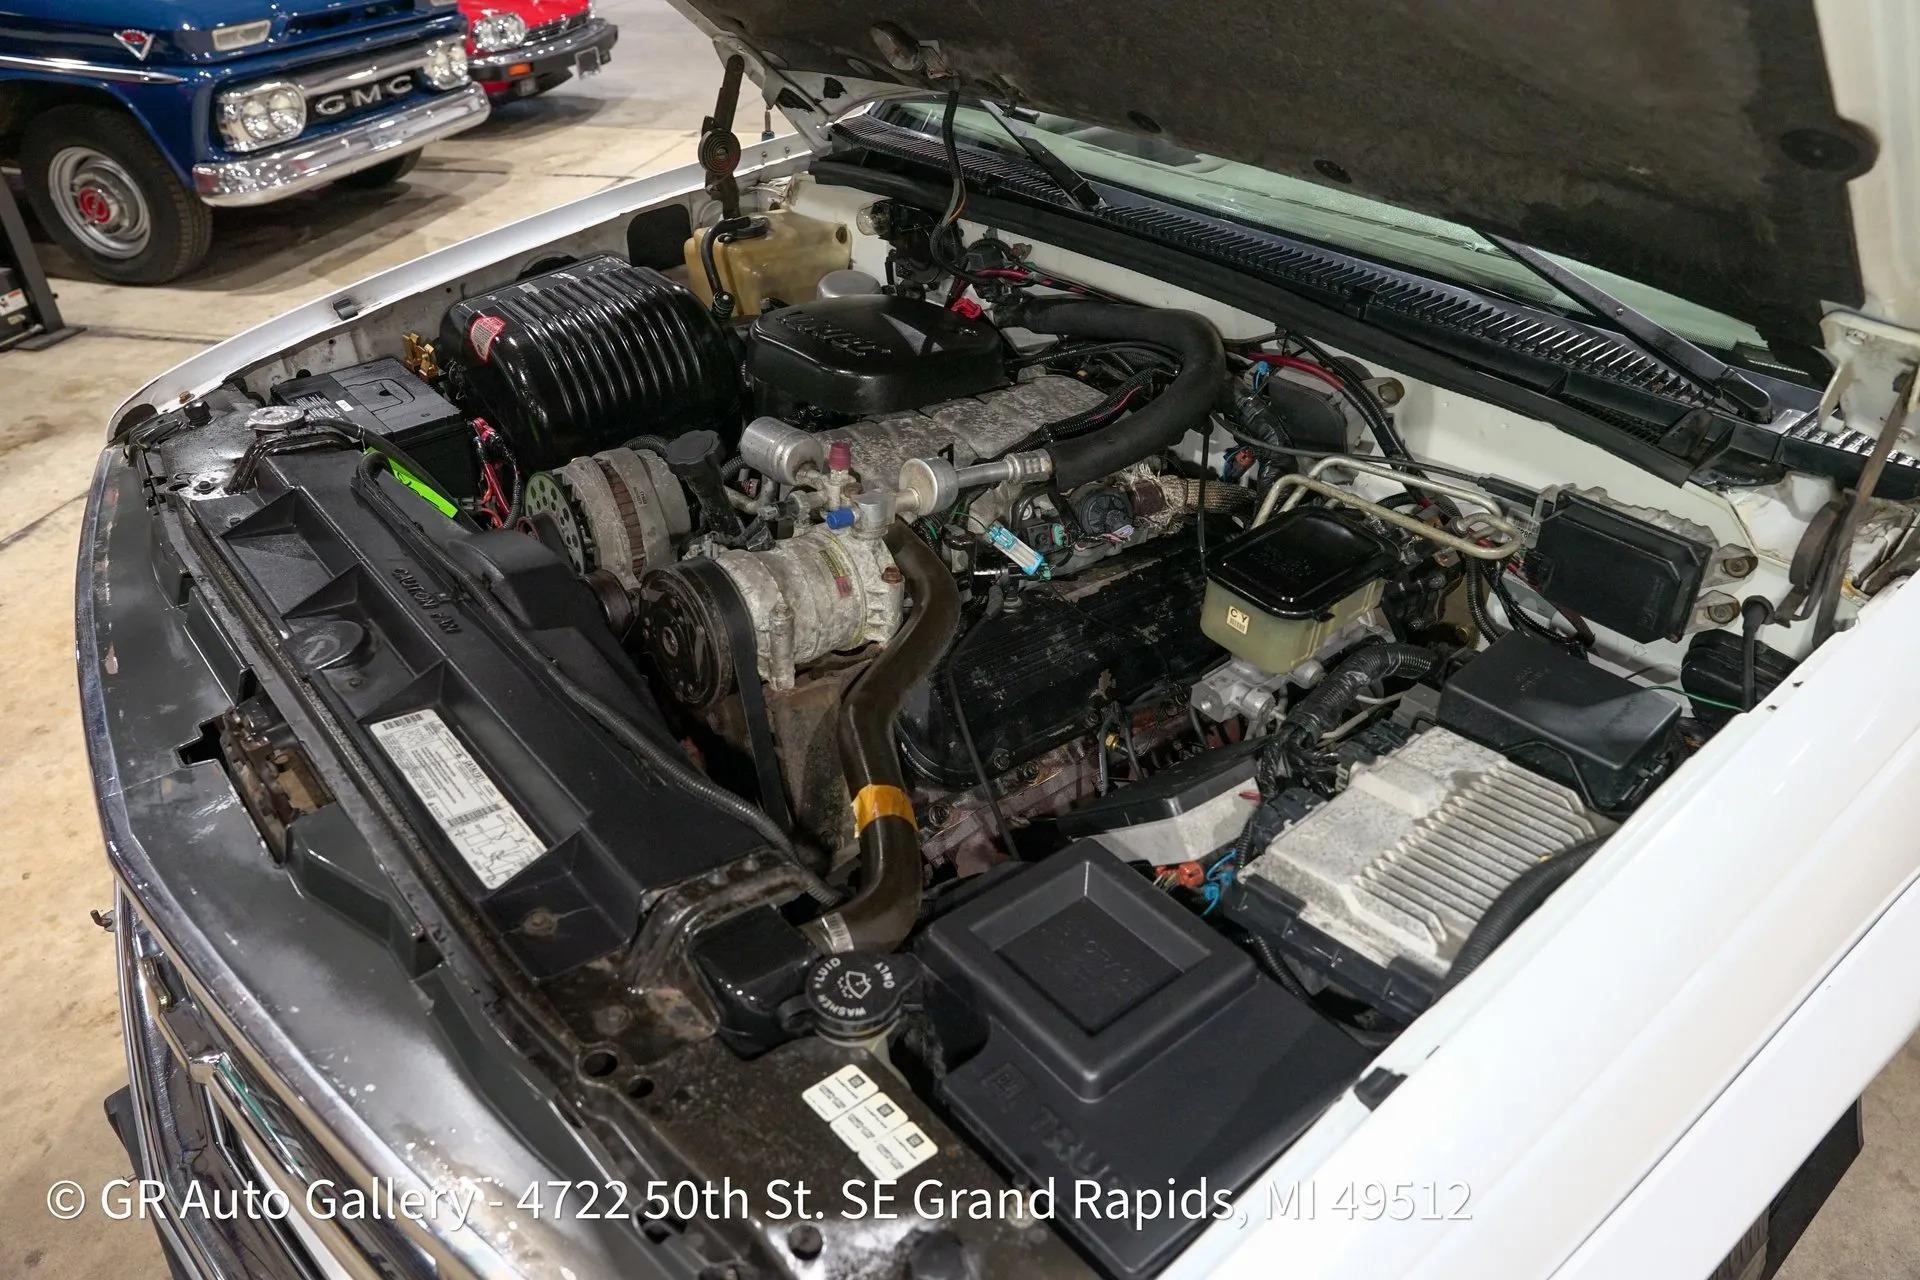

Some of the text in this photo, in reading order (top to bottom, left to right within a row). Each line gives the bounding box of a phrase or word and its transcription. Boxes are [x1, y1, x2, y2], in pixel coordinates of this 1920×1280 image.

[315, 75, 413, 115] GMC
[814, 957, 841, 989] FLUID
[873, 961, 896, 989] ONLY
